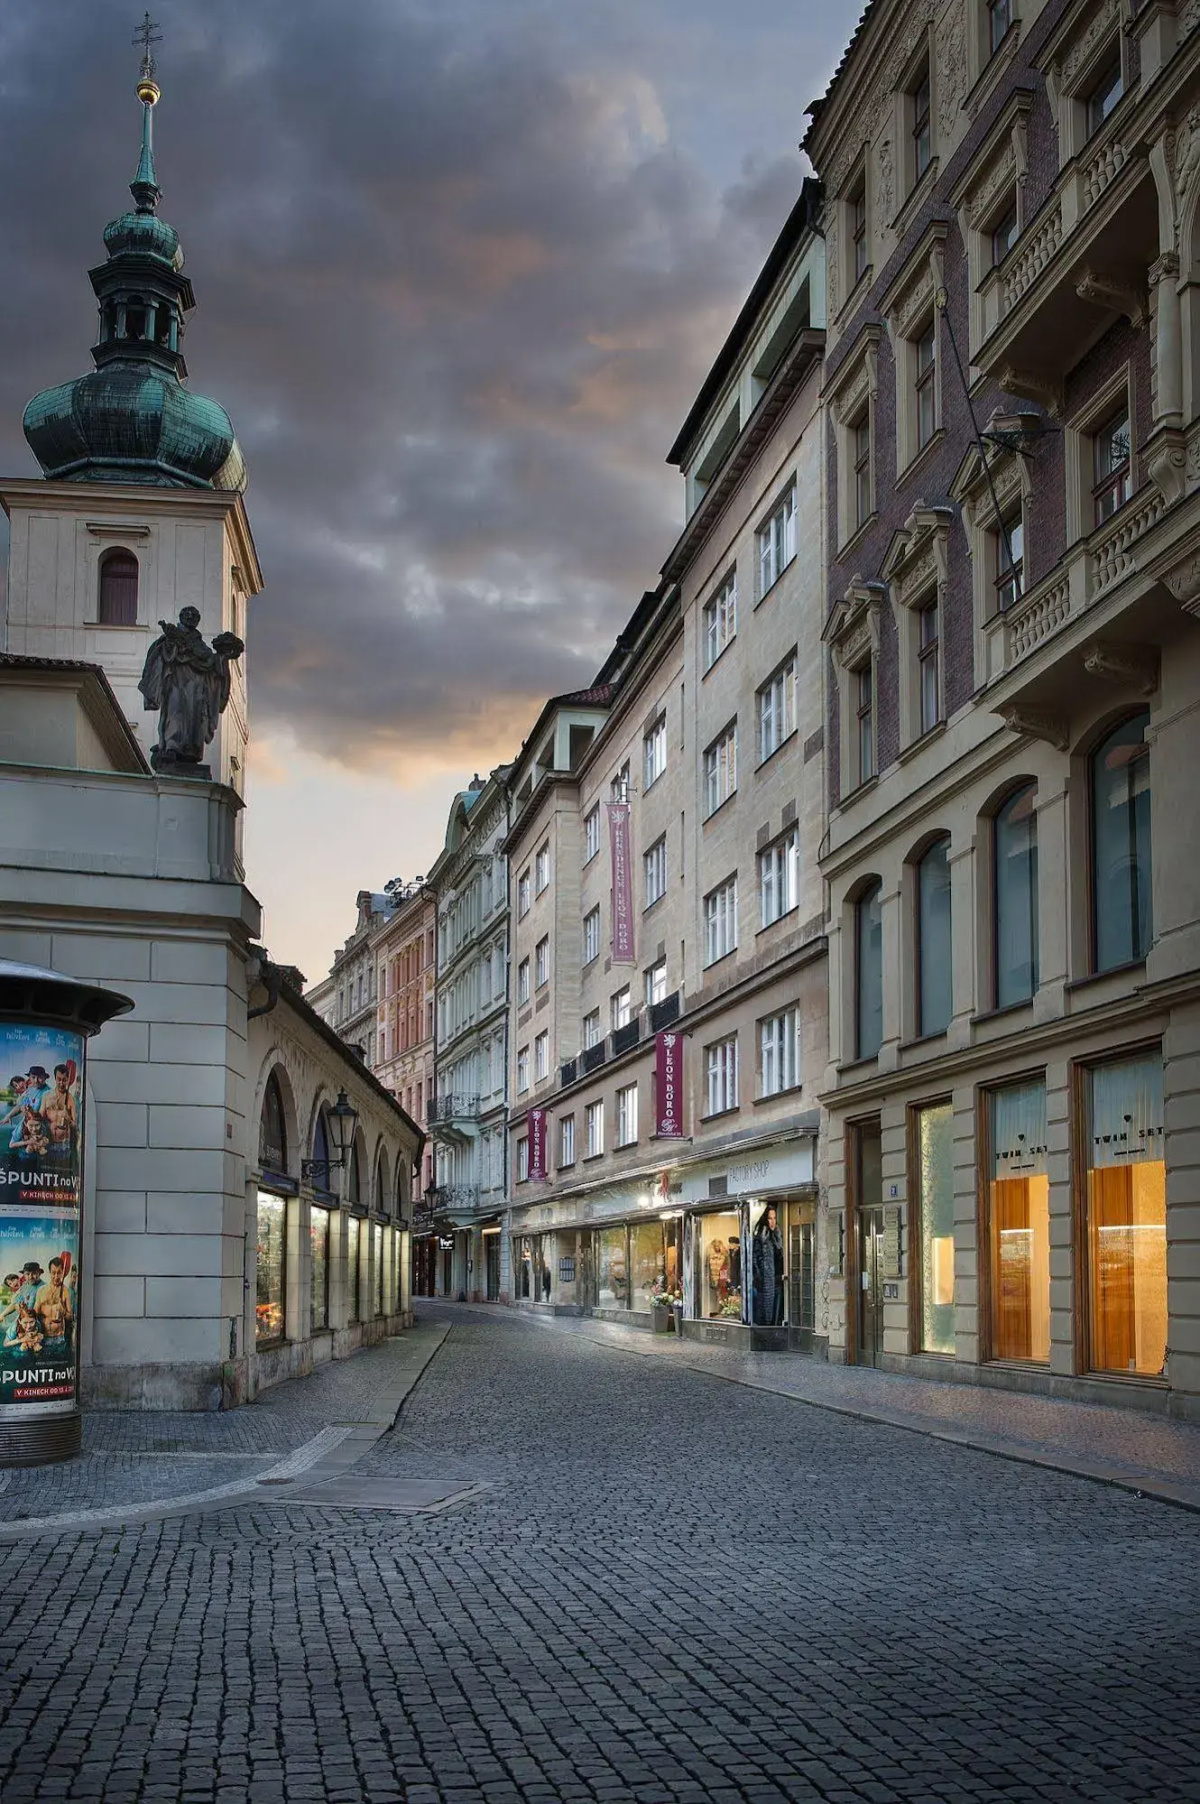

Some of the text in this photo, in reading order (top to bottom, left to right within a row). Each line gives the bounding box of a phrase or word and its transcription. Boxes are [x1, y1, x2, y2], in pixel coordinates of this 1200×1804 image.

[665, 1049, 674, 1082] LEON
[1094, 1126, 1164, 1145] TWIN SET
[996, 1145, 1048, 1160] TWIN SET
[0, 1369, 54, 1384] PUNTI
[23, 1388, 49, 1396] KINECH
